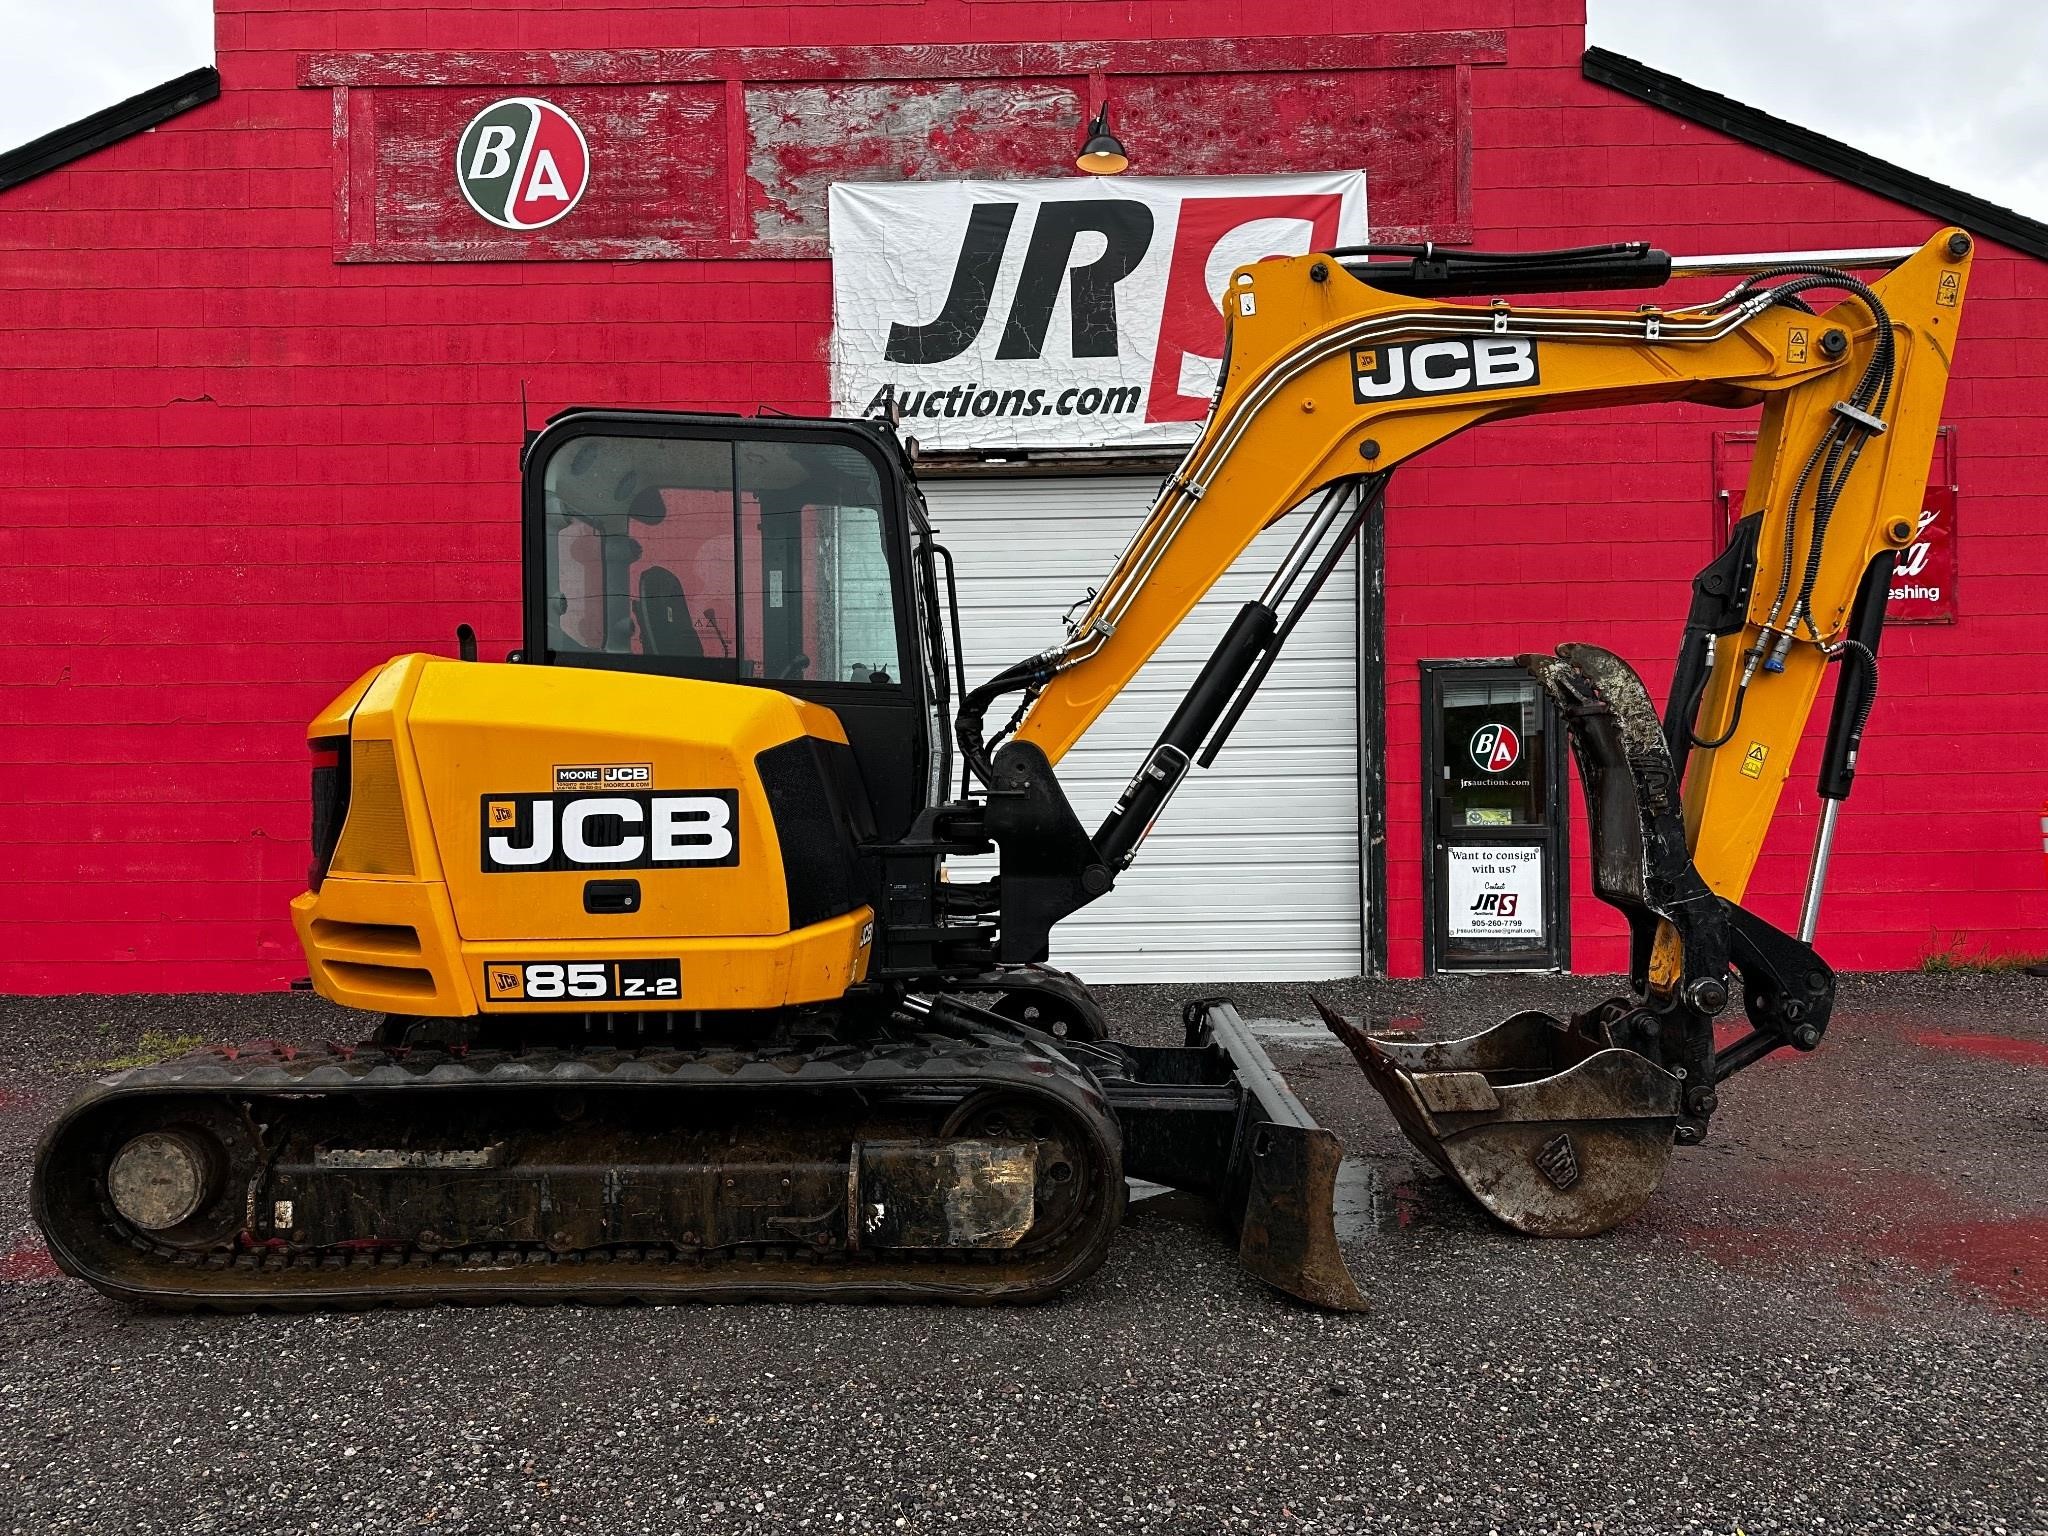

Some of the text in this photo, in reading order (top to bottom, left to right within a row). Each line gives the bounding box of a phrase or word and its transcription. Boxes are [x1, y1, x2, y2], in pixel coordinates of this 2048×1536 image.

[1358, 338, 1535, 397] JCB
[862, 383, 1142, 418] Auctions.com
[1887, 585, 1940, 601] eshing
[560, 770, 598, 780] MOORE
[605, 768, 648, 781] JCB
[1460, 778, 1530, 789] jrsauctions.com
[488, 796, 733, 865] JCB
[1452, 851, 1537, 862] Want to consign
[1472, 865, 1517, 874] with us?
[1470, 893, 1519, 917] JRS
[498, 973, 520, 989] JCB
[526, 963, 678, 998] 85 Z-2
[1541, 1144, 1574, 1184] JCB
